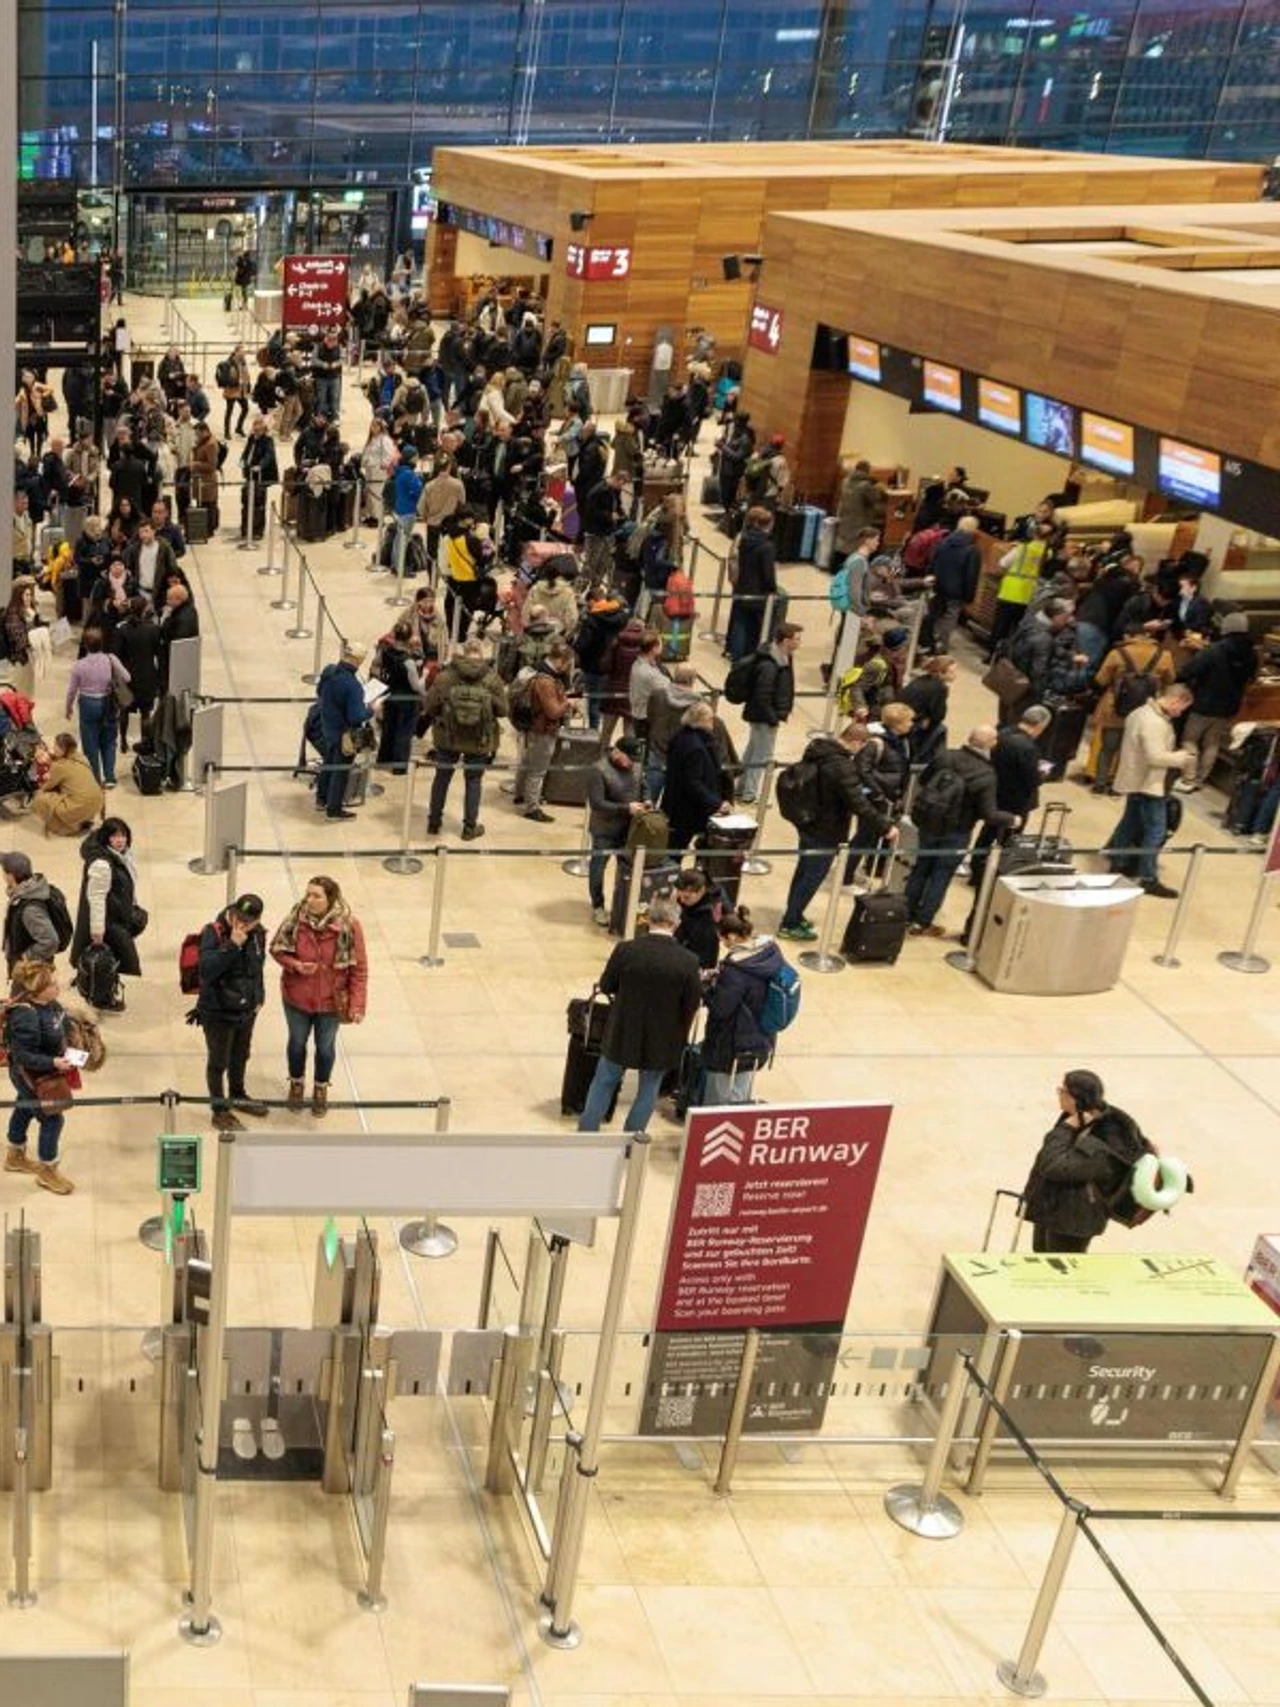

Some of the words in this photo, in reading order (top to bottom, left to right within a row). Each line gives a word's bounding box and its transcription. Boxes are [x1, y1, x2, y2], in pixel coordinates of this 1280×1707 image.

[612, 248, 631, 276] 3
[769, 312, 780, 348] 4
[753, 1116, 810, 1141] BER
[748, 1141, 871, 1167] Runway
[744, 1179, 770, 1190] Jetzt
[770, 1177, 829, 1189] reservieren!
[742, 1191, 780, 1201] Reserve
[688, 1226, 720, 1237] Zutritt
[722, 1226, 740, 1235] nur
[741, 1225, 758, 1234] mit
[685, 1238, 706, 1248] BER
[683, 1250, 704, 1259] und
[723, 1247, 773, 1259] gebuchten
[682, 1261, 722, 1270] Scannen
[724, 1260, 738, 1268] Sie
[740, 1259, 760, 1267] Ihre
[712, 1274, 732, 1285] only
[735, 1272, 756, 1282] with
[678, 1286, 697, 1296] BER
[698, 1285, 735, 1296] Runway
[738, 1283, 790, 1293] reservation
[675, 1297, 694, 1306] and
[695, 1297, 707, 1306] at
[707, 1296, 723, 1306] the
[725, 1294, 760, 1305] booked
[674, 1308, 697, 1318] Scan
[697, 1308, 719, 1318] your
[721, 1305, 763, 1316] boarding
[1087, 1365, 1158, 1381] Security
